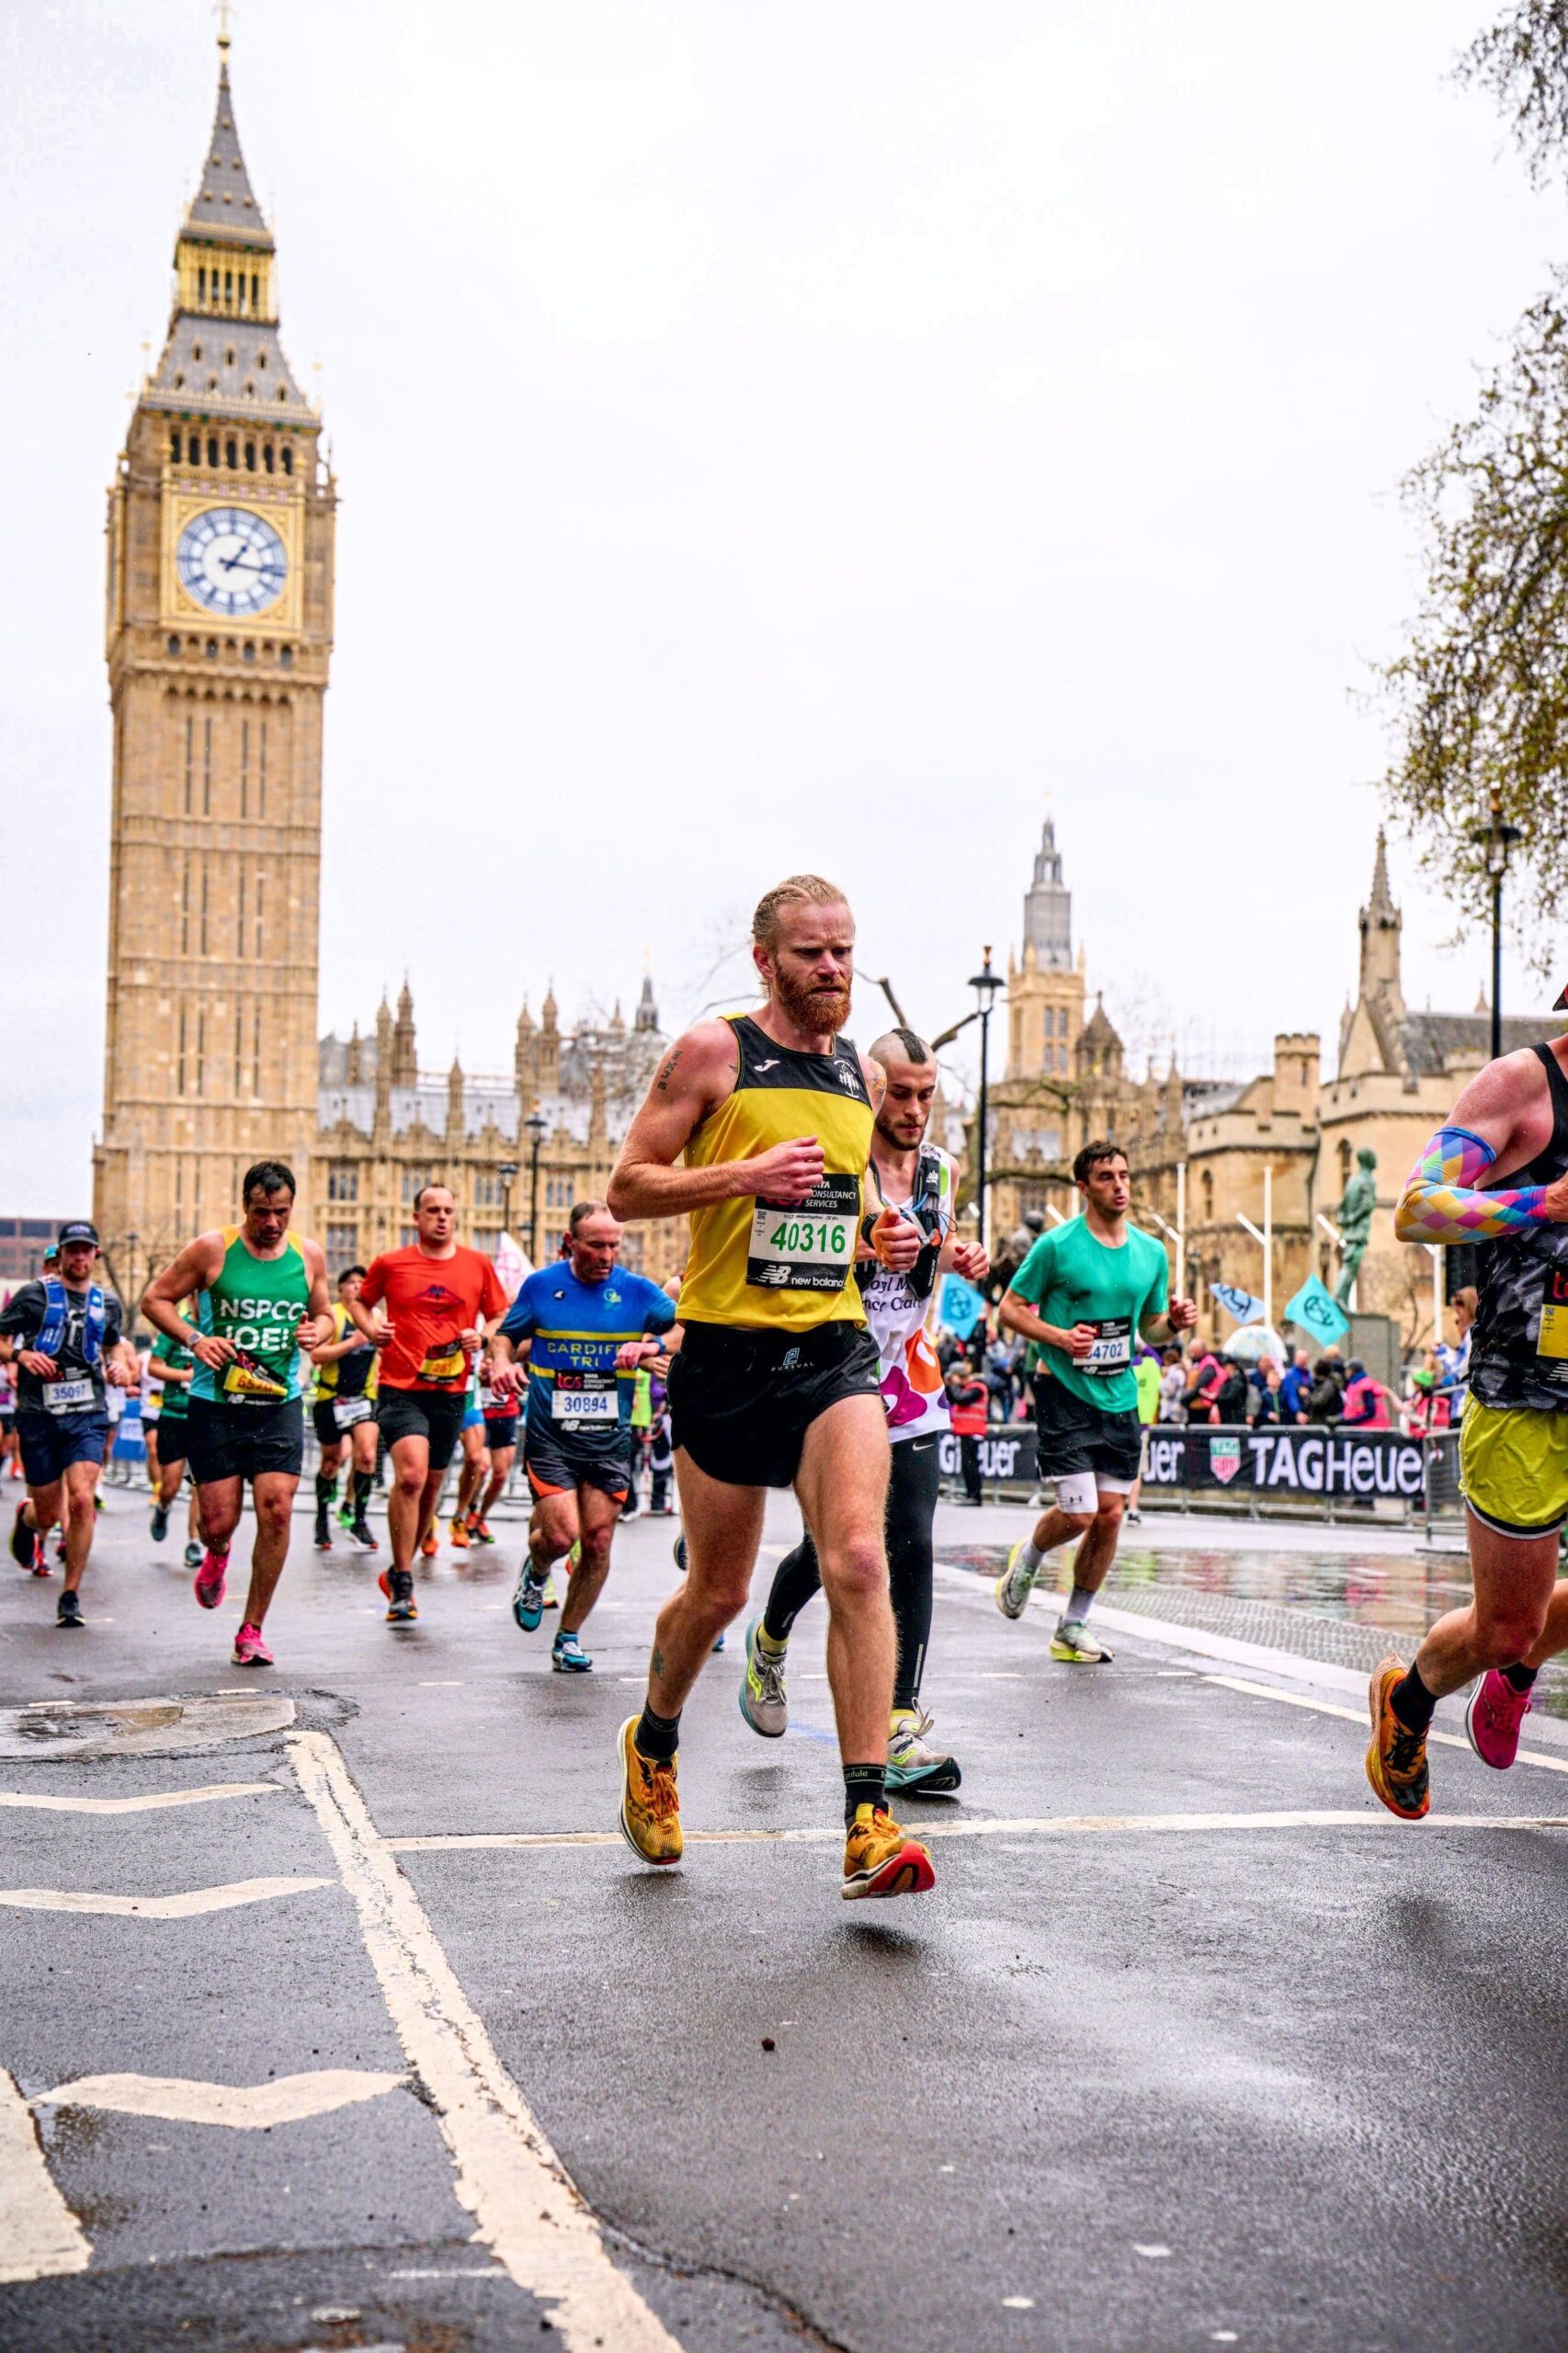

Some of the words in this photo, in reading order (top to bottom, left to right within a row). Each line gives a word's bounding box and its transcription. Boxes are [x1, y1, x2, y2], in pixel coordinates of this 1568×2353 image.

[812, 1190, 857, 1199] ONSULTANCY
[805, 1199, 838, 1209] SERVICES
[769, 1222, 846, 1254] 40316
[790, 1276, 812, 1286] new
[221, 1298, 306, 1322] NSPCC
[570, 1356, 599, 1369] TRI
[770, 1362, 814, 1372] PURSUAL
[558, 1372, 583, 1389] tcs
[52, 1384, 85, 1400] 35097
[564, 1396, 608, 1412] 30894
